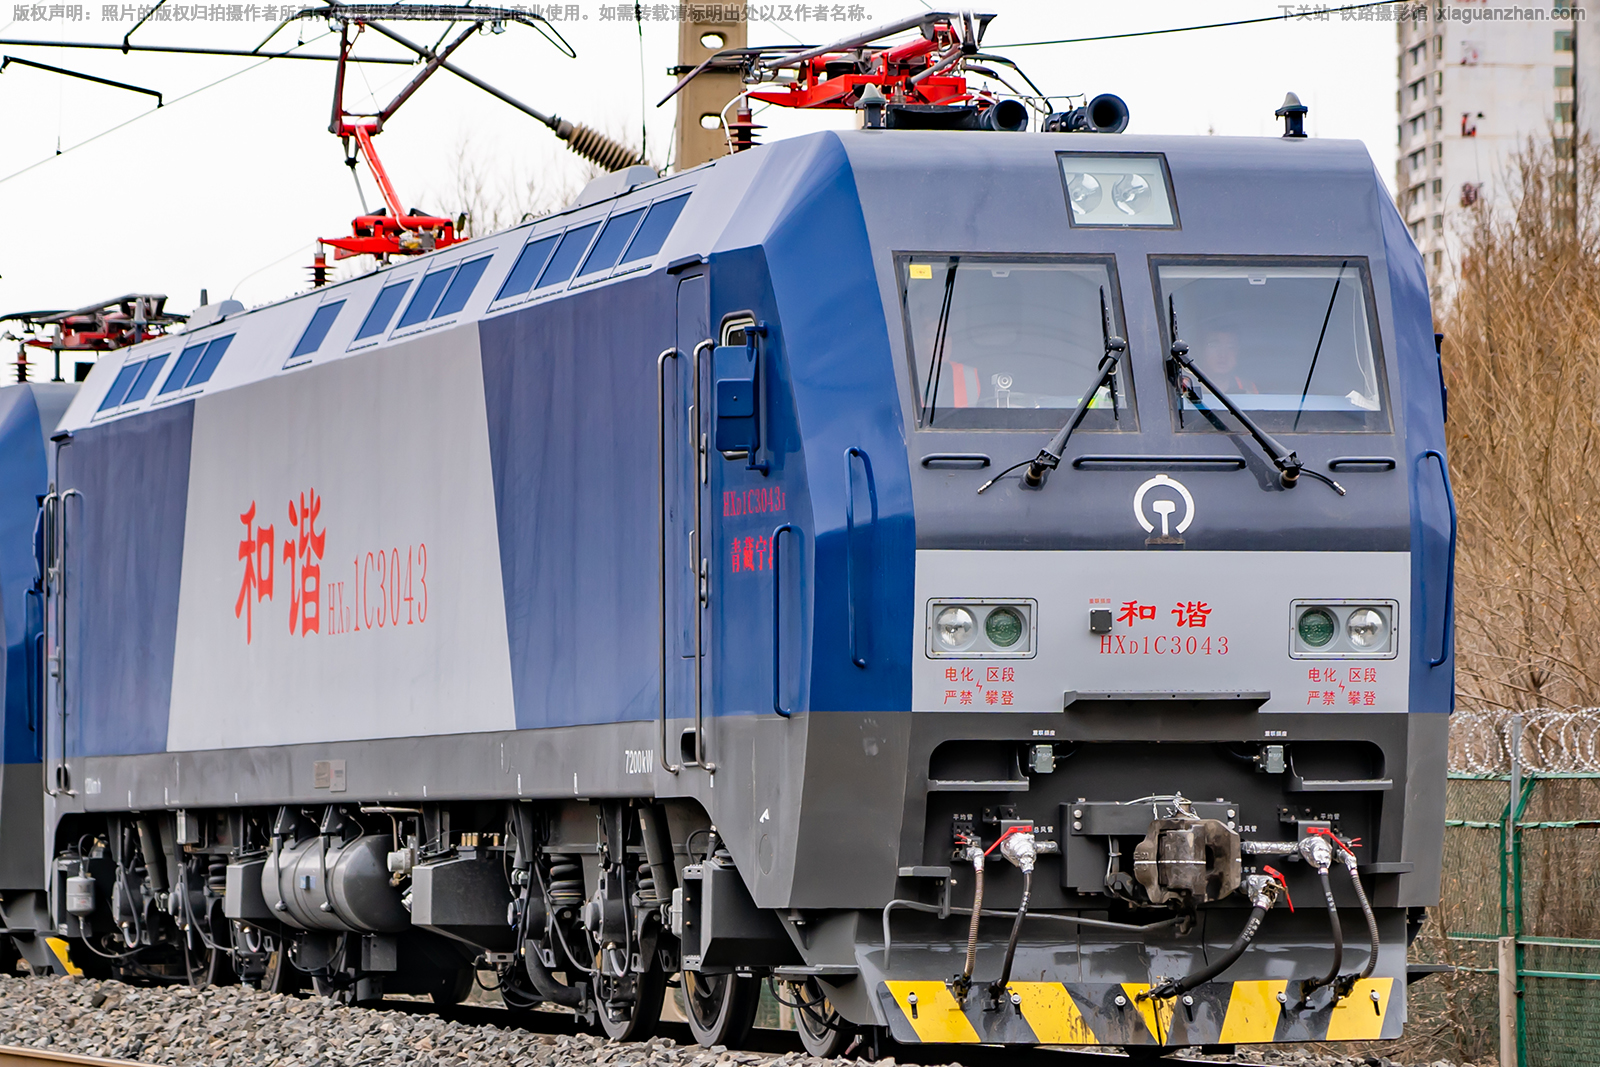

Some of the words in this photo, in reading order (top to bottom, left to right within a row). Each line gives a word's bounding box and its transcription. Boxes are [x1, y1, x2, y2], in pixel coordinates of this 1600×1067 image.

[234, 486, 326, 646] 和谐
[1116, 600, 1213, 628] 和谐
[1099, 634, 1230, 656] HXD1C3043
[945, 666, 974, 682] 电化
[986, 666, 1015, 682] 区段
[1308, 667, 1337, 683] 电化
[1349, 667, 1377, 683] 区段
[944, 690, 973, 705] 严禁
[985, 690, 1015, 705] 攀登
[1307, 691, 1336, 706] 严禁
[1348, 691, 1377, 706] 攀登
[625, 749, 654, 774] 7200kW
